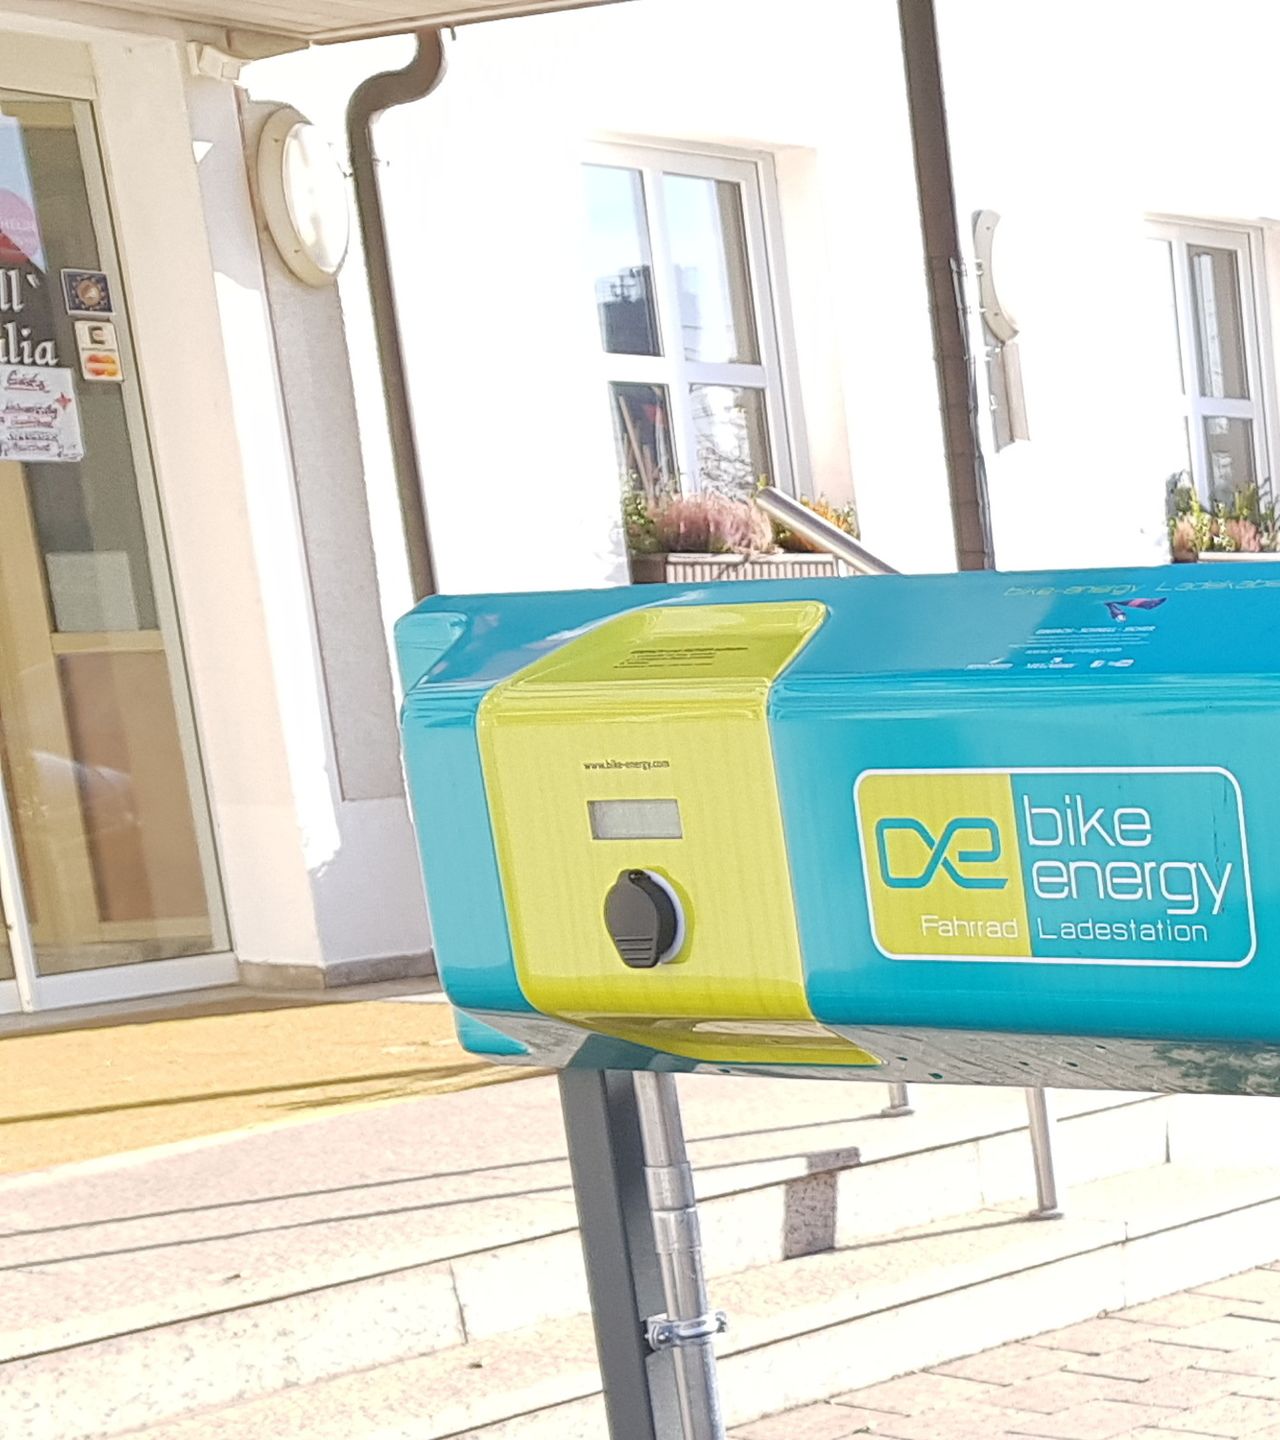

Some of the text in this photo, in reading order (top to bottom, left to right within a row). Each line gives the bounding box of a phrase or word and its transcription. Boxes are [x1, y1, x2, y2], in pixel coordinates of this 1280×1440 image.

[583, 759, 670, 771] www.bike-energy.com
[1023, 794, 1152, 847] bike
[1031, 860, 1233, 916] energy
[920, 914, 1209, 943] Fahrrad Ladestation
